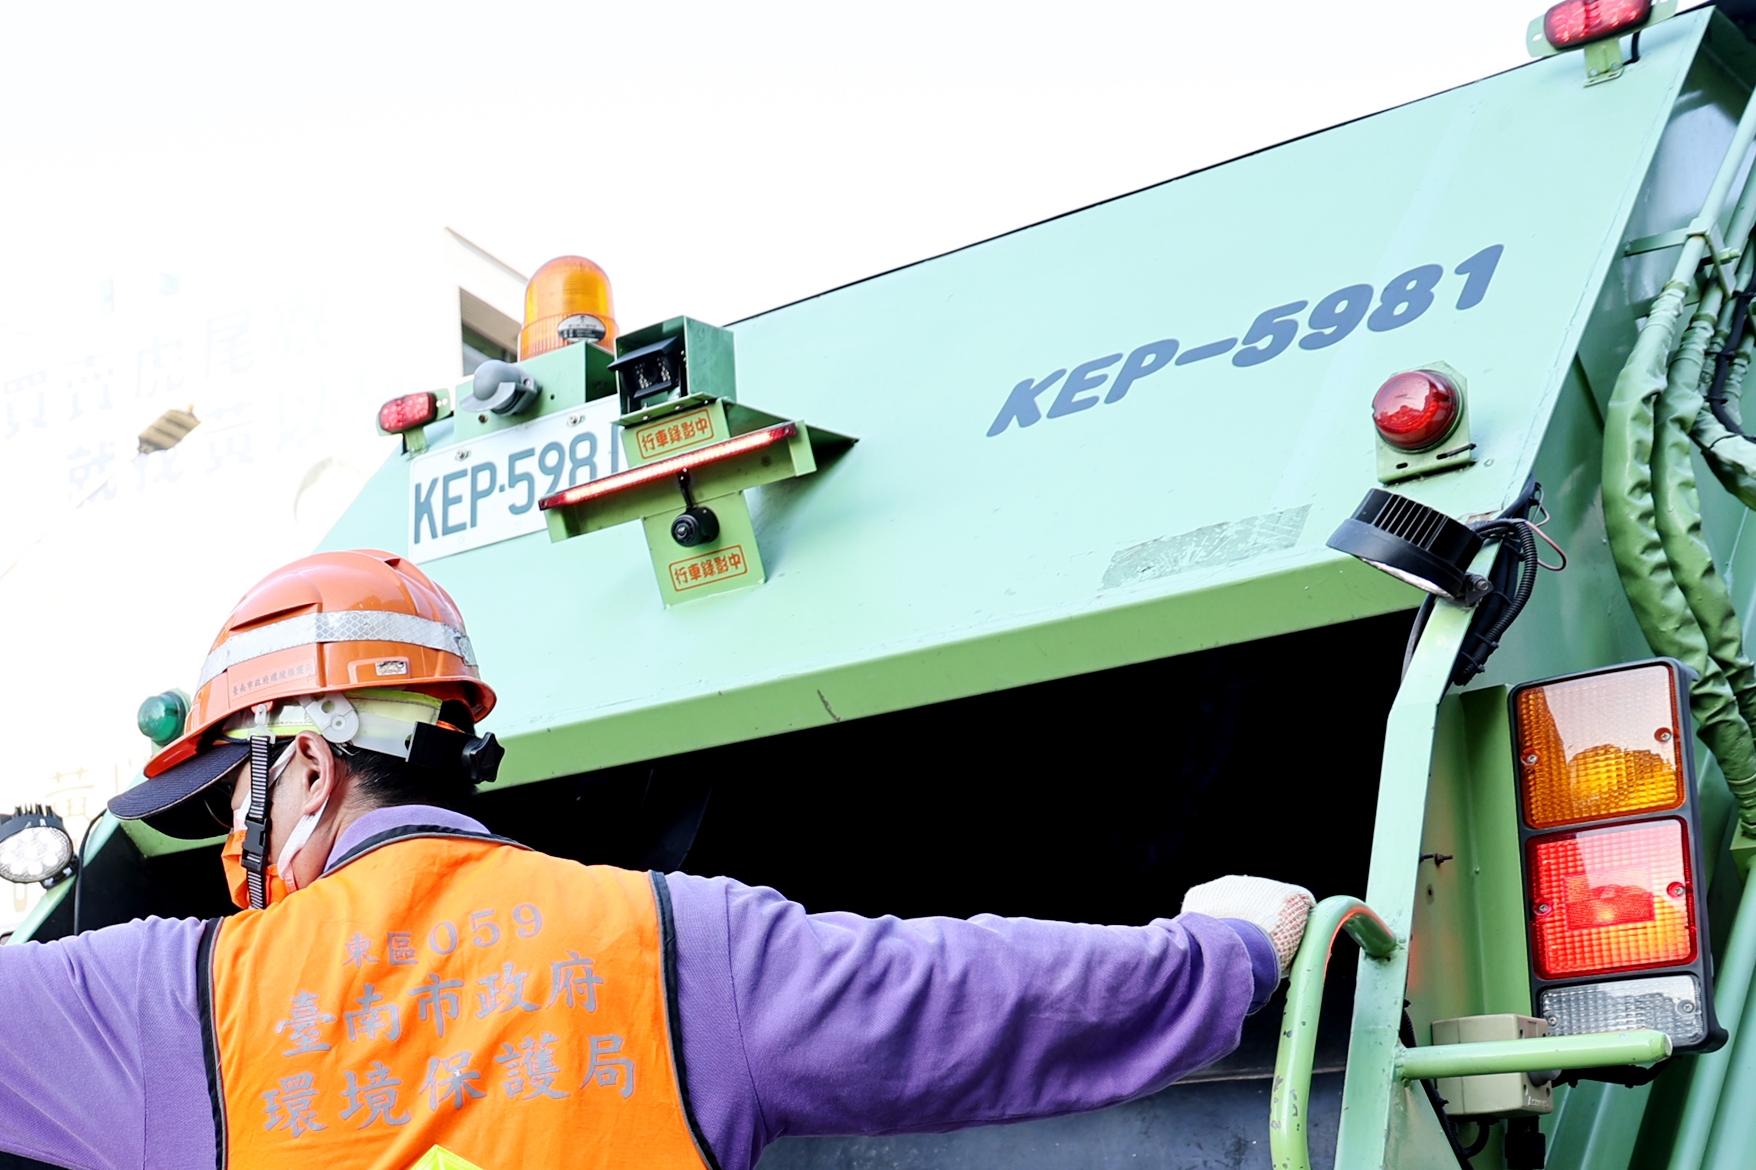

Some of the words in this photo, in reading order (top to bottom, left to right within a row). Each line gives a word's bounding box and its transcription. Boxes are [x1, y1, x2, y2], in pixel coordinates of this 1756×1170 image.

[986, 243, 1504, 437] KEP-5981
[641, 416, 710, 452] 行車錄影中
[674, 552, 742, 584] 行車錄影中
[275, 951, 604, 1057] 臺南市政府
[261, 1032, 636, 1138] 環境保護局
